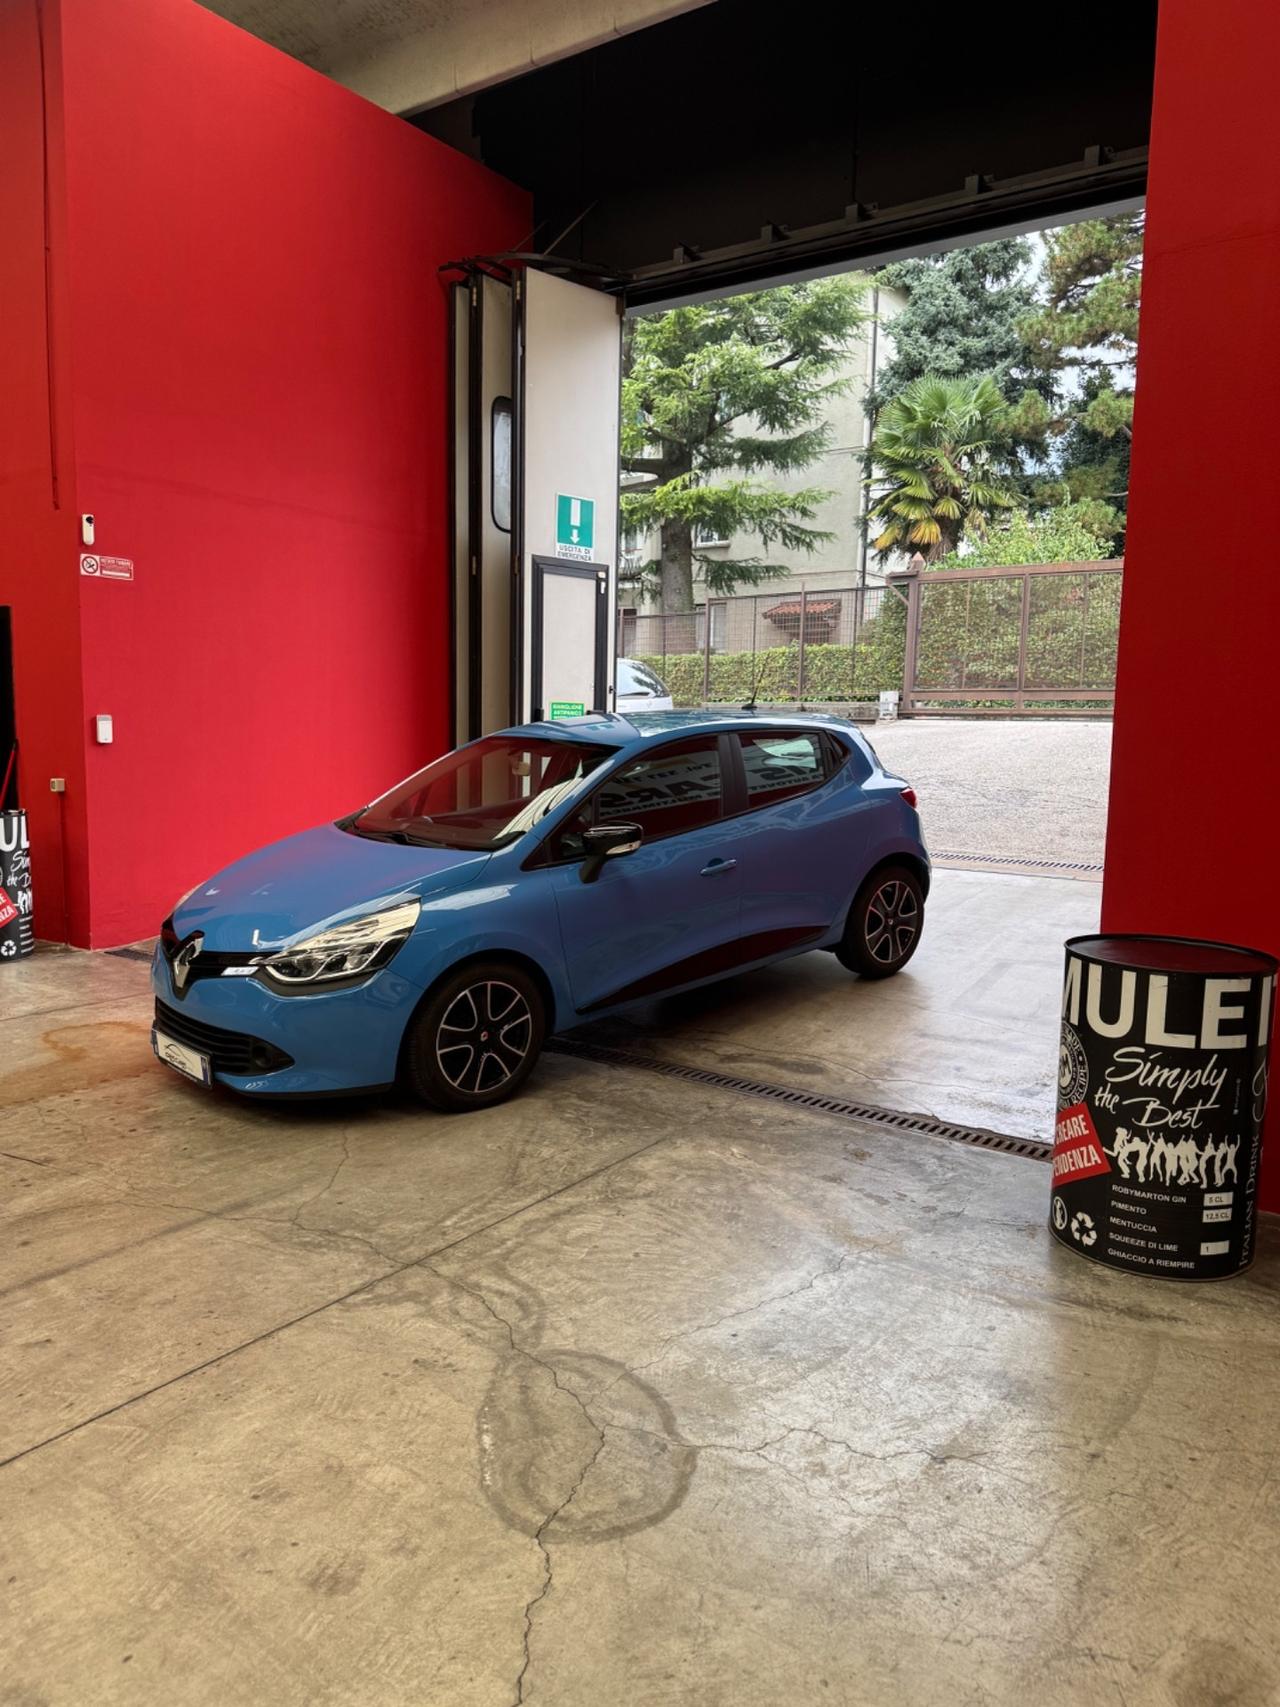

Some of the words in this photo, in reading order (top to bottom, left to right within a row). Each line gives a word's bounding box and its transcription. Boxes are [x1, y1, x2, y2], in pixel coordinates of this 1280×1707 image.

[559, 545, 583, 554] USCITA
[1105, 1046, 1228, 1108] Simply
[1094, 1082, 1120, 1114] the
[1121, 1097, 1220, 1129] Best
[1112, 1184, 1170, 1203] ROBYMARTON
[1171, 1195, 1187, 1203] GIN
[1110, 1200, 1147, 1215] PIMENTO
[1219, 1211, 1229, 1219] CL
[1109, 1216, 1158, 1233] MENTUCCIA
[1109, 1232, 1146, 1247] SQUEEZE
[1148, 1241, 1157, 1249] DI
[1158, 1243, 1179, 1252] LIME
[1107, 1247, 1147, 1264] GHIACCIO
[1156, 1259, 1195, 1269] RIEMPIRE
